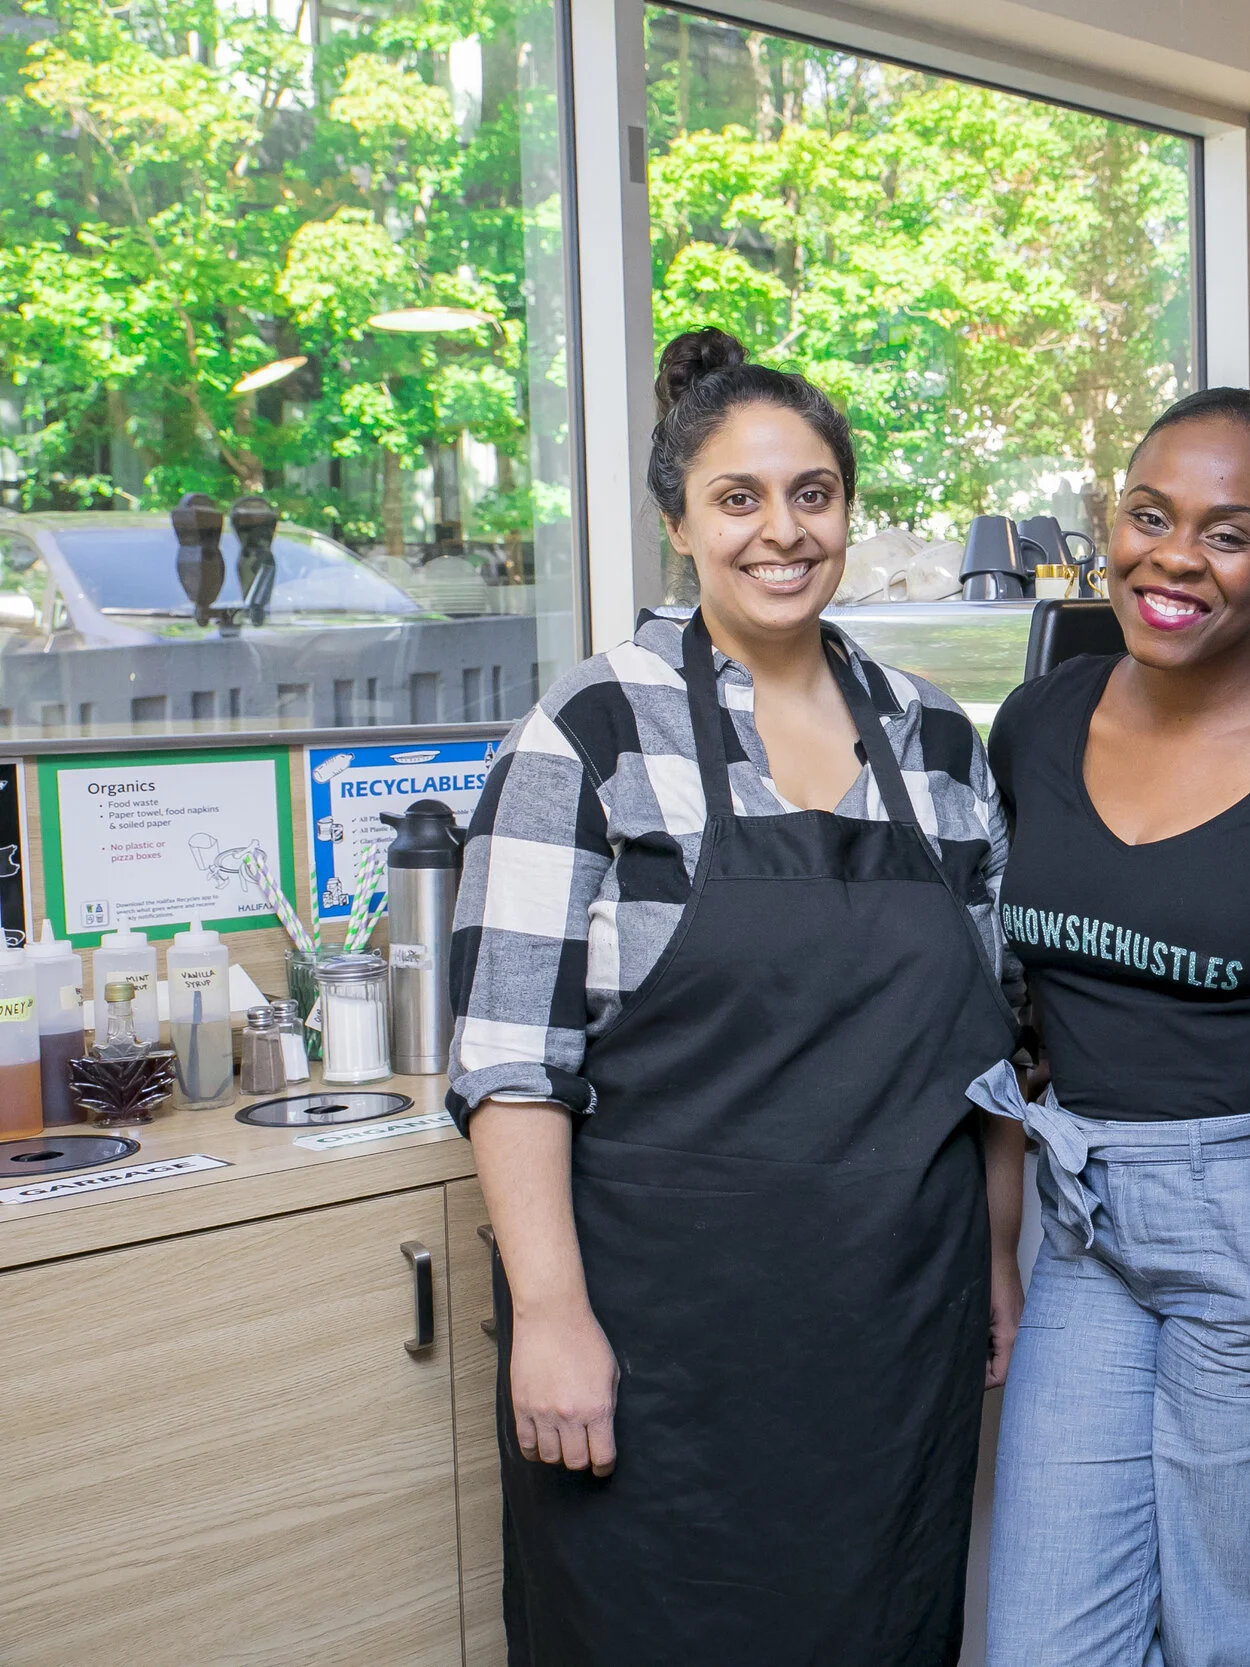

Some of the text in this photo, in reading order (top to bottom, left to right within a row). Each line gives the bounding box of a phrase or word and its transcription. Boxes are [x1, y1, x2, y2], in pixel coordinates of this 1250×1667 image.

[88, 780, 156, 797] Organics
[341, 773, 486, 798] RECYCLABLES
[108, 799, 159, 809] Food waste
[109, 805, 220, 821] Paper towel, food napkins
[119, 820, 145, 829] soiled
[147, 820, 172, 829] paper
[125, 841, 154, 852] plastic
[156, 840, 166, 848] or
[111, 851, 162, 863] pizza boxes
[1003, 903, 1243, 991] @HOWSHEHUSTLES
[126, 974, 149, 982] MINT
[181, 969, 216, 980] VANILLA
[184, 980, 211, 988] SYRUP
[19, 1161, 196, 1196] GARBAGE
